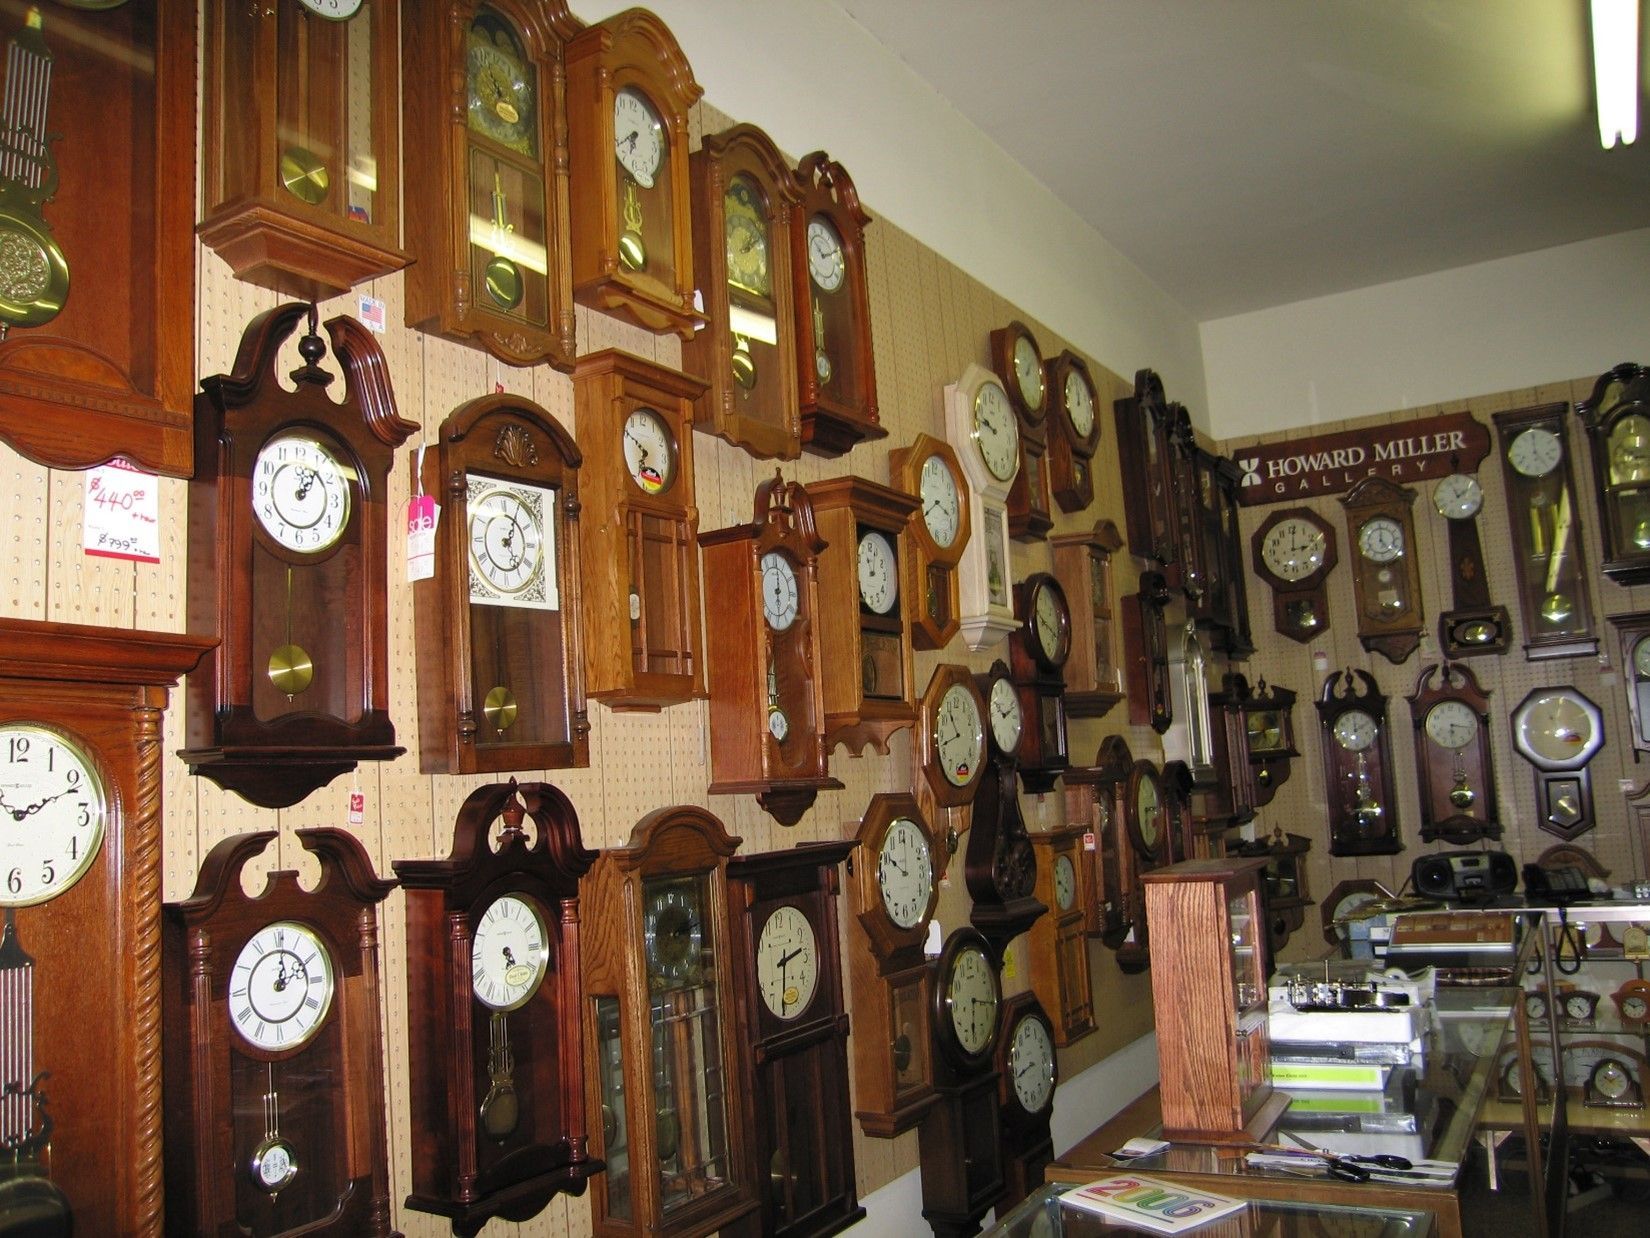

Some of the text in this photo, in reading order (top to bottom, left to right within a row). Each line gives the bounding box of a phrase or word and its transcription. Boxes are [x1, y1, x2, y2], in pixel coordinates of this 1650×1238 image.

[296, 447, 306, 458] 12
[1267, 430, 1467, 479] HOWARD MILLER
[264, 461, 274, 475] 10
[1275, 461, 1426, 493] GALLERY
[409, 505, 432, 533] sale
[10, 738, 30, 763] 12
[67, 769, 79, 793] 2
[78, 803, 90, 827] 3
[65, 836, 78, 860] 4
[8, 868, 22, 894] 6
[42, 860, 55, 884] 5
[1085, 1179, 1215, 1218] 2006
